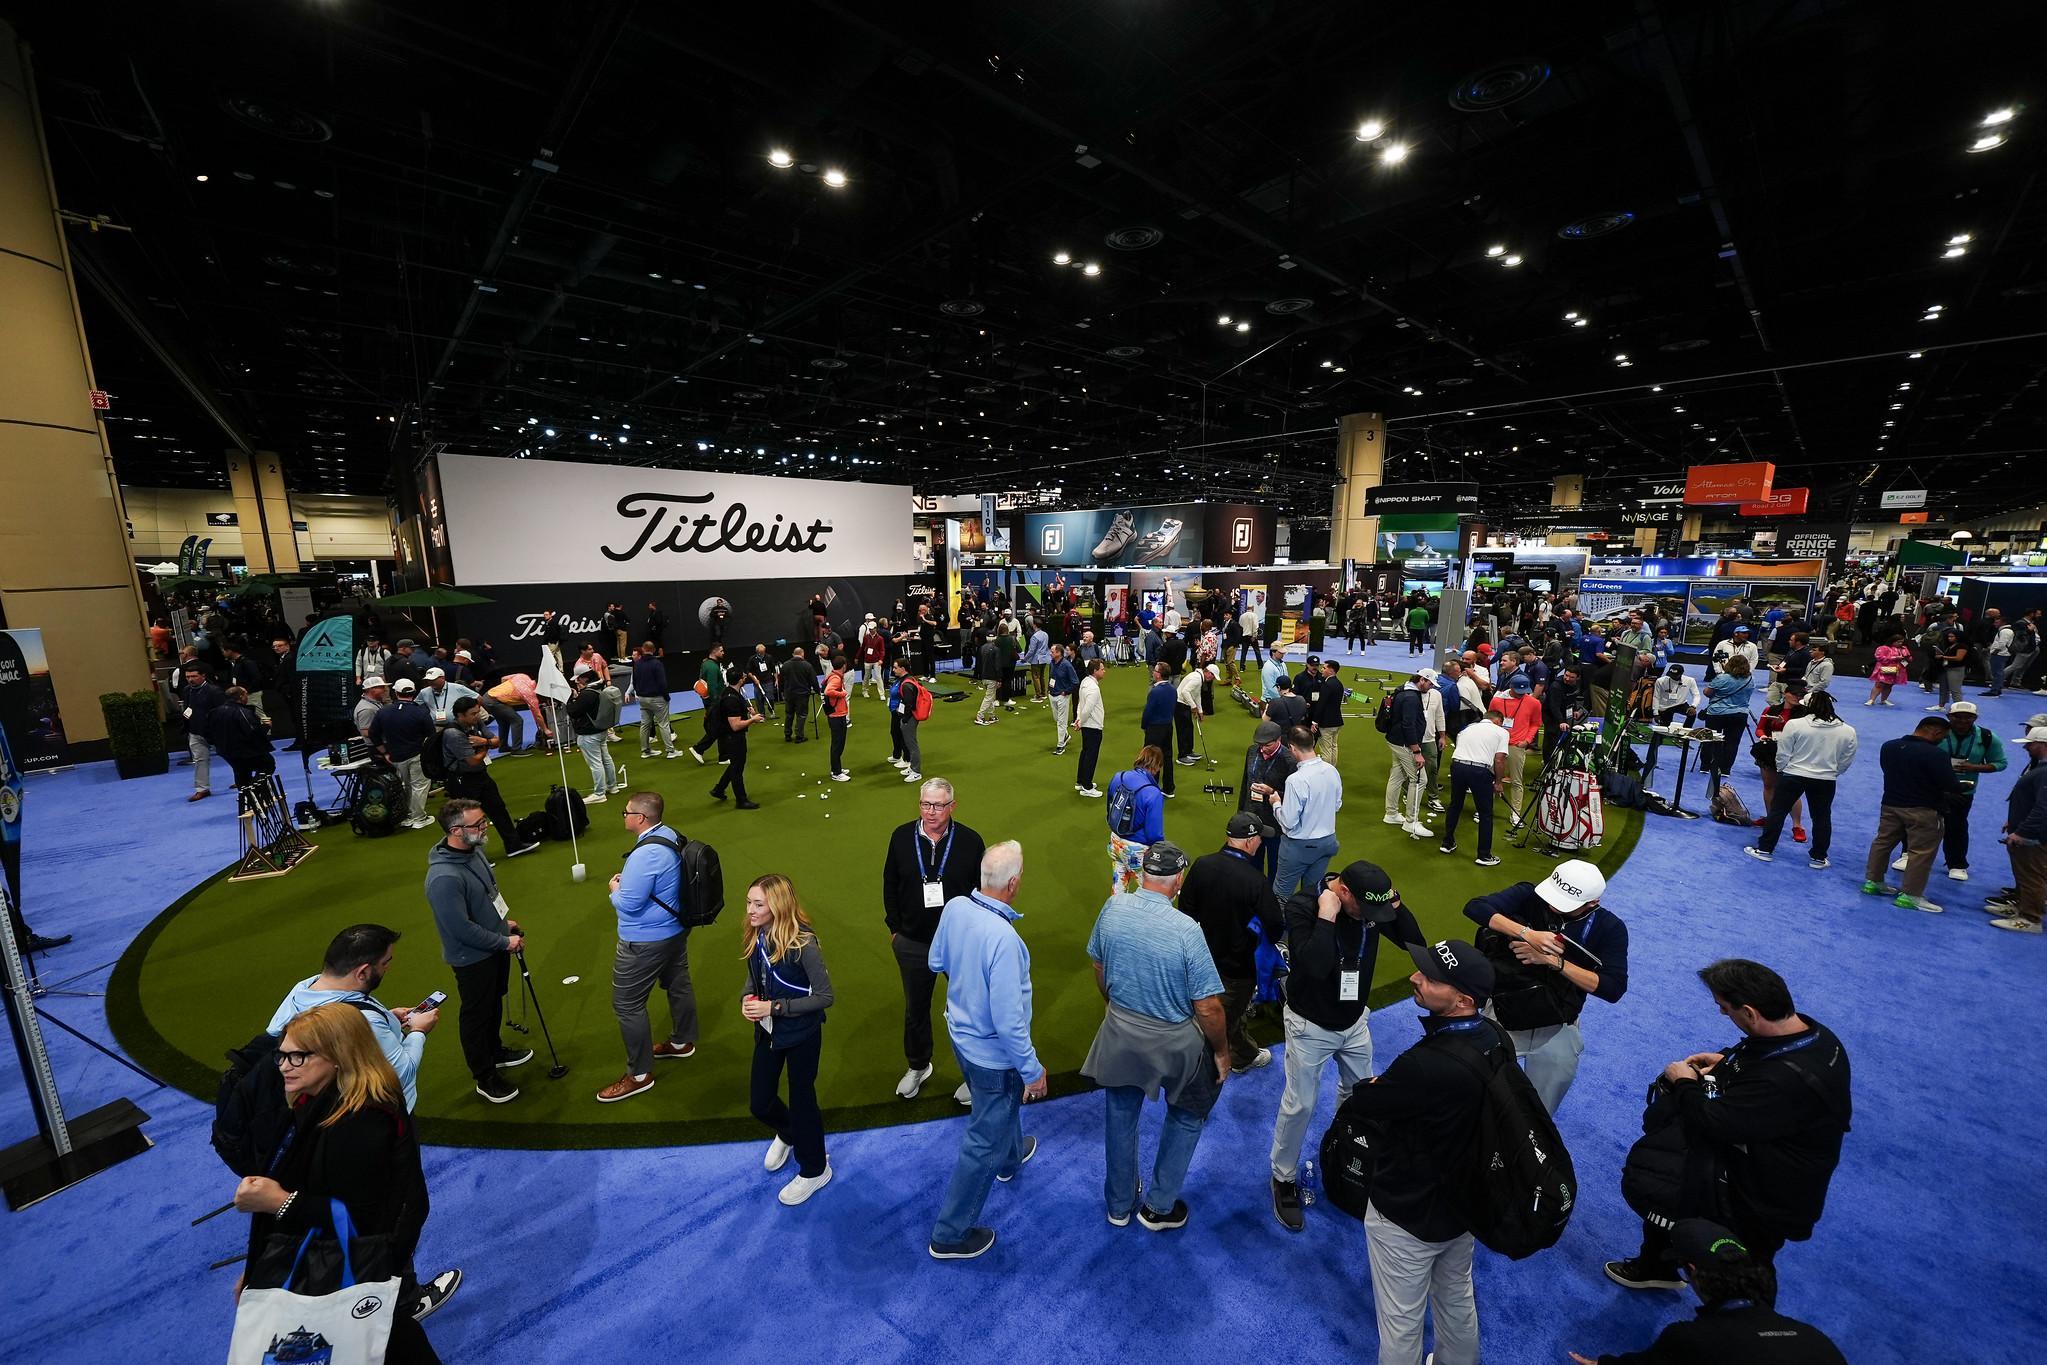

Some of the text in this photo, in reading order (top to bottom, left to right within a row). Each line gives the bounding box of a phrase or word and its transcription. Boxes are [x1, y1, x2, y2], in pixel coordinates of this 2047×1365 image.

[1367, 430, 1374, 442] 3
[231, 462, 239, 472] 2
[269, 464, 277, 473] 2
[1380, 496, 1409, 504] NIPPON
[1769, 494, 1792, 503] 2G
[913, 498, 937, 511] NG
[1621, 513, 1670, 523] NVISAGE
[600, 491, 833, 562] Titleist
[1786, 540, 1838, 549] RANGE
[1791, 549, 1828, 558] TECH
[1551, 871, 1583, 899] SNYDER
